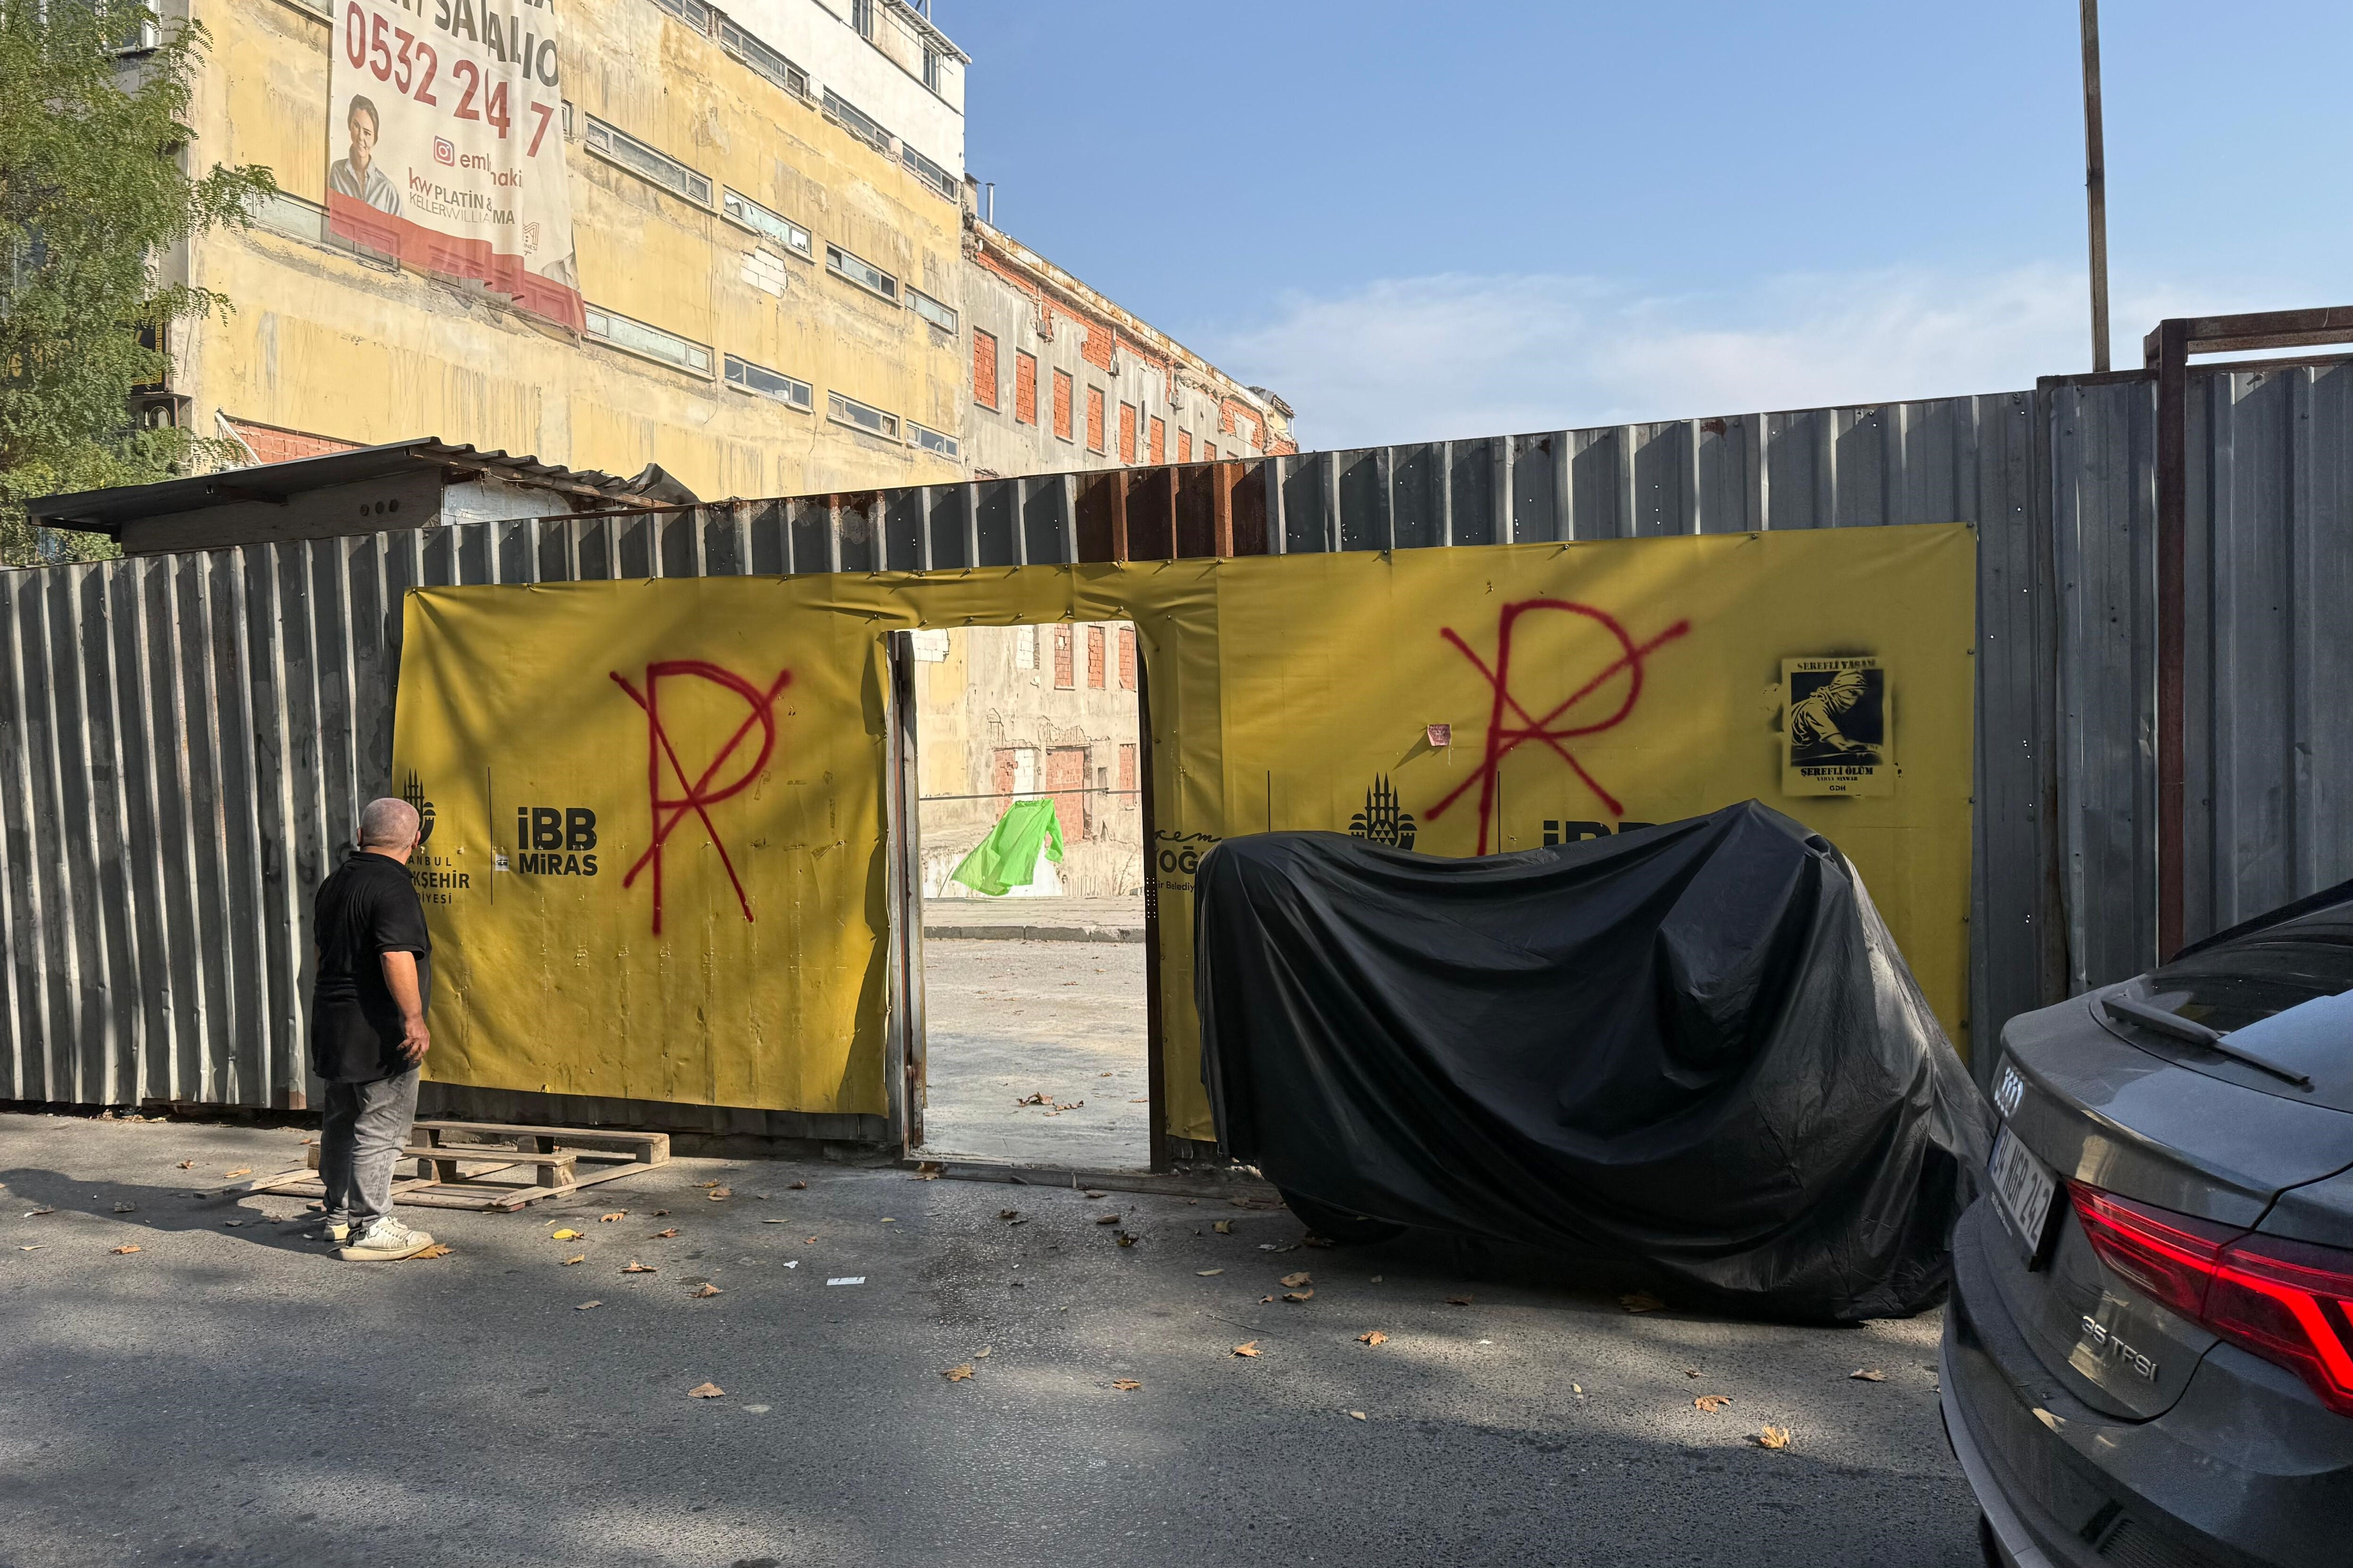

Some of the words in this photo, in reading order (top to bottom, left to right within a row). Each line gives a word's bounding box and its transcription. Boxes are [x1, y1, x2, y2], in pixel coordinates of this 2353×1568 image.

[346, 1, 437, 106] 0532
[527, 100, 554, 157] 7
[410, 191, 490, 223] KELLERWILLIA
[408, 855, 452, 866] ANBUL
[412, 870, 470, 889] KŞEHİR
[1166, 881, 1195, 892] Belediy
[2019, 1171, 2050, 1243] 242
[2082, 1315, 2107, 1344] 35
[2111, 1335, 2157, 1381] TFSI
